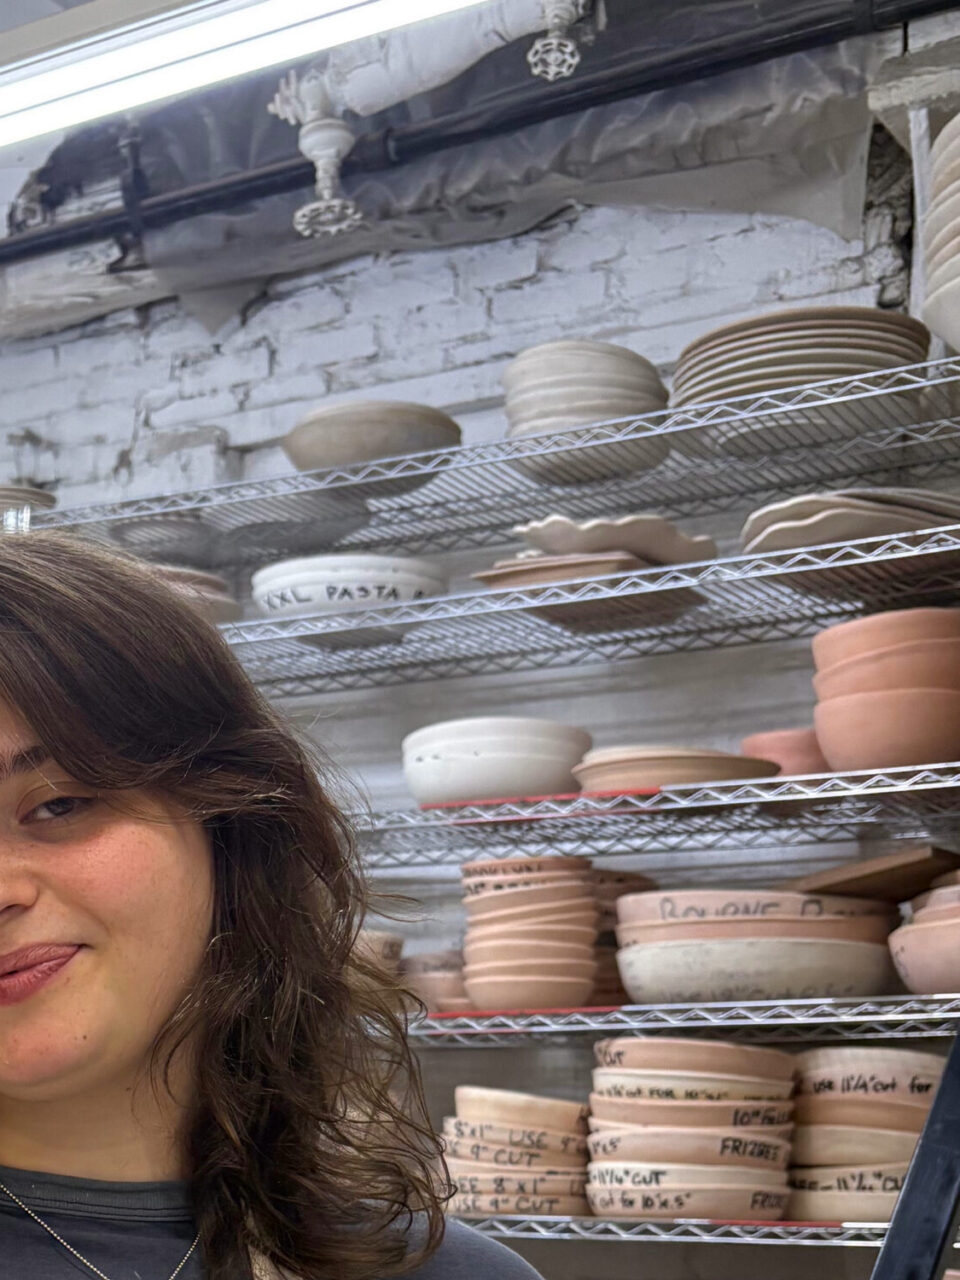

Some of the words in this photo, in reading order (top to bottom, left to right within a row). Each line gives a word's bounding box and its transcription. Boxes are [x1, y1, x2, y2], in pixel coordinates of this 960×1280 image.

[263, 589, 313, 611] XXL
[326, 585, 399, 600] PASTA
[493, 1148, 542, 1167] CUT
[631, 1170, 666, 1186] CUT
[515, 1196, 560, 1213] CUT
